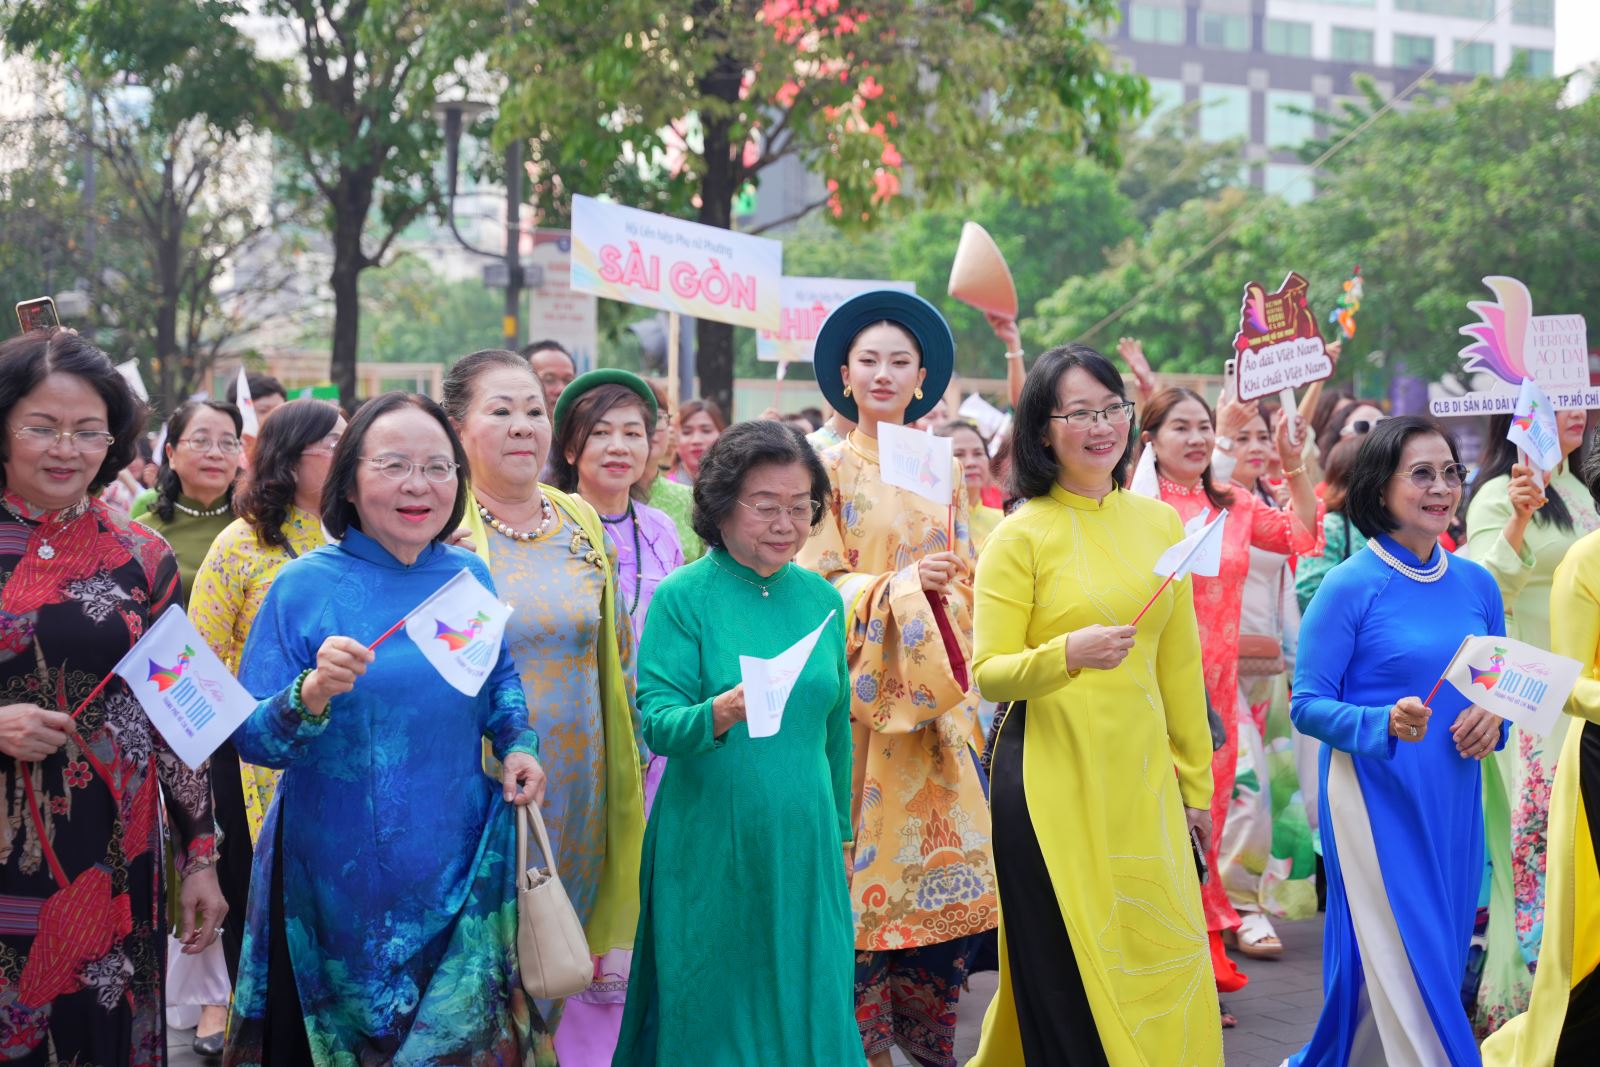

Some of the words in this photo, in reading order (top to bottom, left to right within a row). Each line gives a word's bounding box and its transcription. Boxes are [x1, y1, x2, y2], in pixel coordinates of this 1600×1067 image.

[599, 240, 660, 291] SÀI
[670, 257, 756, 311] GÒN
[1531, 318, 1584, 332] VIETNAM
[1533, 333, 1582, 347] HERITAGE
[1276, 347, 1294, 362] Việt
[1297, 343, 1319, 358] Nam
[1262, 369, 1282, 388] chất
[1284, 365, 1302, 381] Việt
[1305, 361, 1327, 375] Nam
[1434, 401, 1450, 414] CLB
[1453, 401, 1461, 412] DI
[1496, 396, 1509, 410] DÀI
